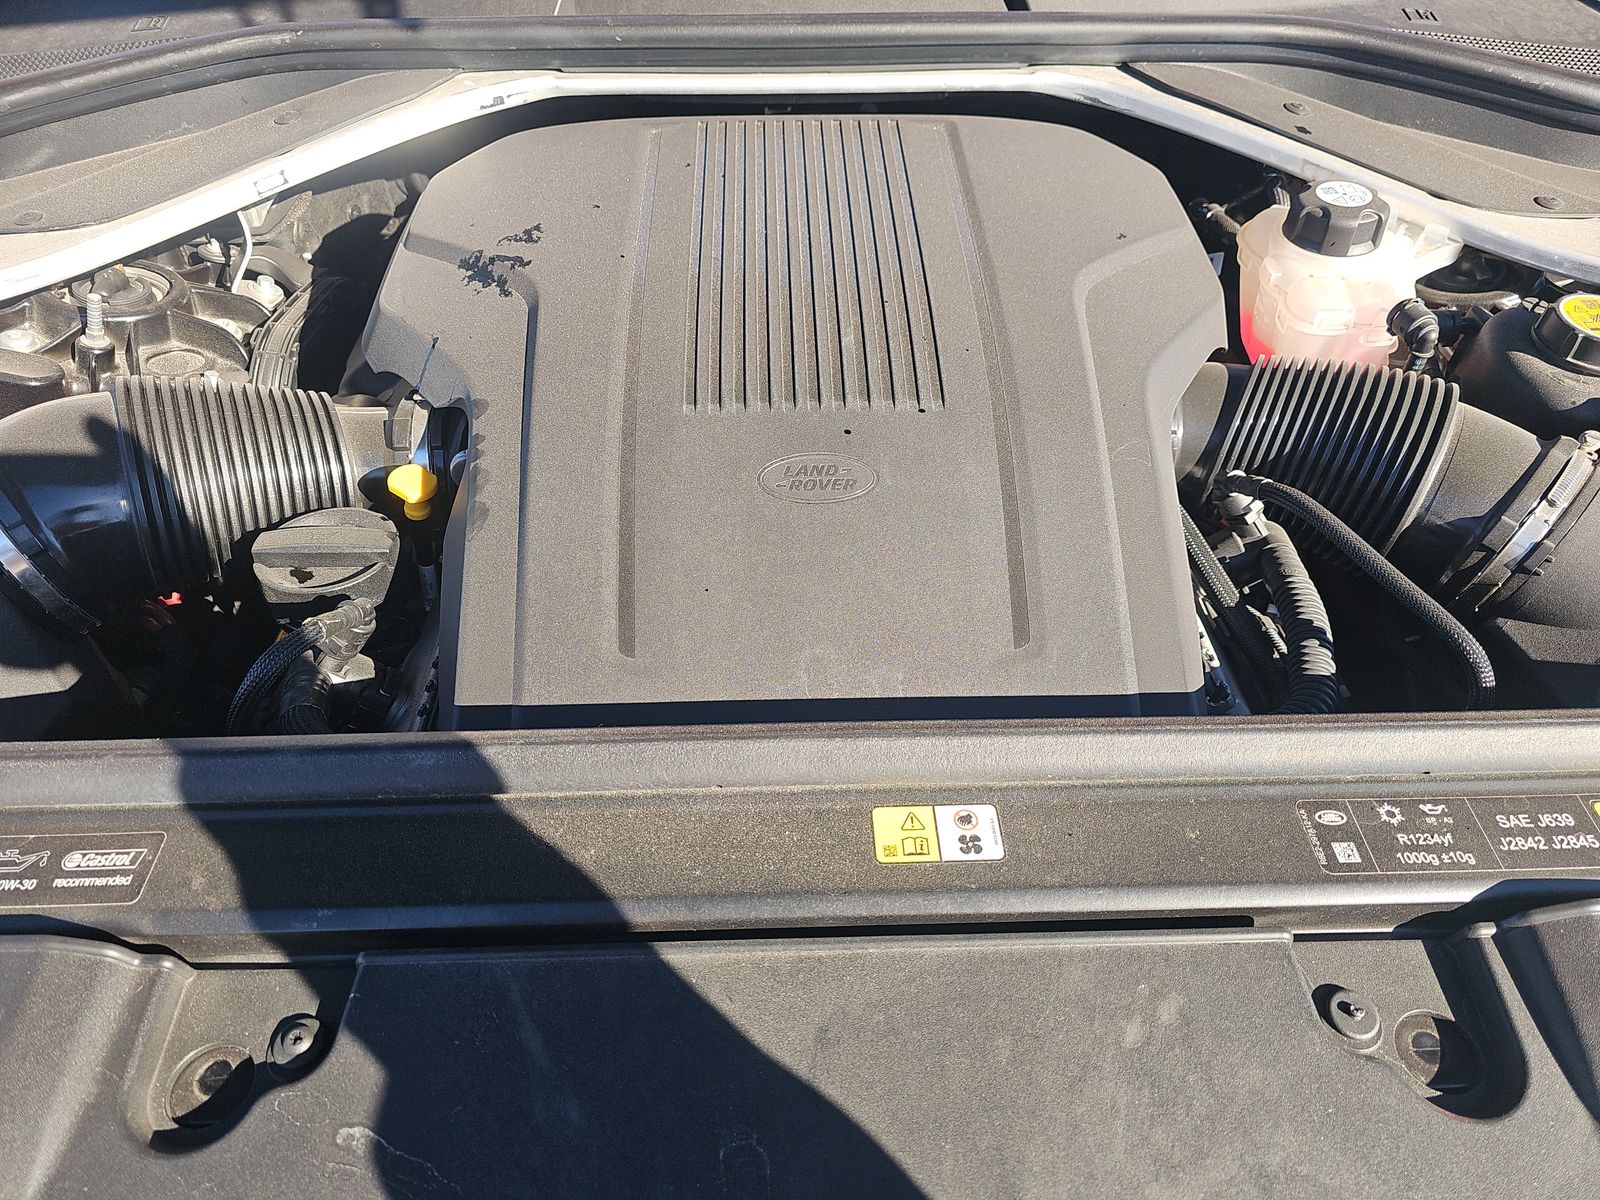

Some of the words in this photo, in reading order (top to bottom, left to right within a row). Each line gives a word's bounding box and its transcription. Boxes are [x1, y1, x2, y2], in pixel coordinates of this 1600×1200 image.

[1495, 814, 1535, 828] SAE
[1537, 813, 1575, 827] J639
[1397, 833, 1454, 847] R1234yf
[1500, 836, 1549, 850] J2842
[1551, 834, 1600, 849] J2845
[80, 852, 136, 867] Castrol
[1396, 851, 1440, 866] 1000g
[1441, 851, 1476, 865] ±10g
[52, 874, 134, 888] recommended
